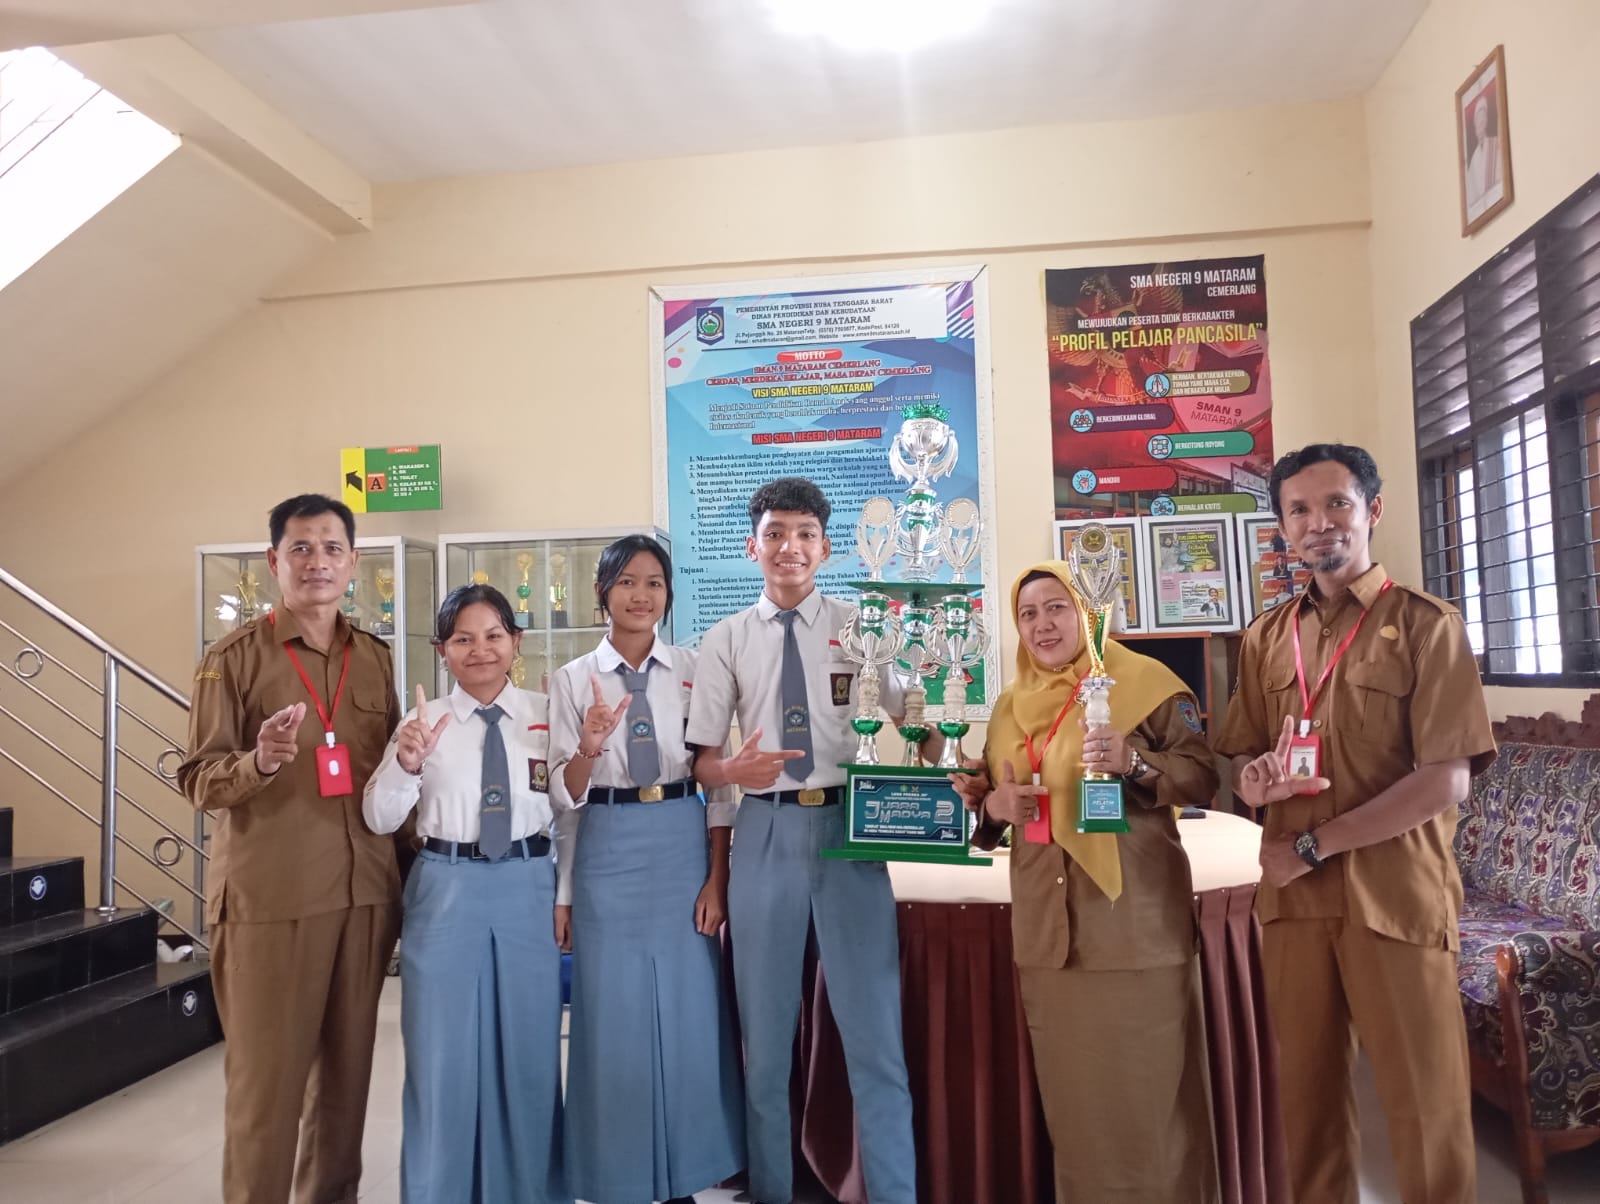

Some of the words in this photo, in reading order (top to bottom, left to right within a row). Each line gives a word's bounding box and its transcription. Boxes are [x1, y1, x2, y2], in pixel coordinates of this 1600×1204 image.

[1130, 274, 1154, 289] SMA
[1155, 271, 1192, 287] NEGERI
[1194, 270, 1202, 284] 9
[1204, 268, 1256, 284] MATARAM
[1207, 284, 1257, 297] CEMERLANG
[736, 304, 779, 313] PEMERINTAH
[781, 302, 812, 311] PROVINSI
[773, 310, 814, 319] PENDIDIKAN
[1077, 317, 1127, 329] MEWUJUDKAN
[1128, 314, 1160, 326] PESERTA
[1161, 312, 1181, 324] DIDIK
[1182, 310, 1235, 322] BERKARAKTER
[756, 321, 776, 330] SMA
[779, 318, 813, 328] NEGERI
[824, 316, 871, 326] MATARAM
[1112, 328, 1173, 349] PELAJAR
[794, 351, 826, 360] MOTTO
[785, 363, 826, 371] MATARAM
[828, 360, 880, 369] CEMERLANG
[706, 377, 740, 386] CERDAS,
[742, 375, 783, 384] MERDEKA
[784, 373, 822, 381] BELAJAR,
[824, 371, 847, 379] MASA
[849, 370, 876, 378] DEPAN
[878, 366, 931, 376] CEMERLANG
[1173, 380, 1189, 388] TUHAN
[752, 388, 769, 398] VISI
[770, 387, 789, 397] SMA
[791, 385, 821, 396] NEGERI
[823, 384, 829, 394] 9
[830, 382, 874, 394] MATARAM
[1196, 401, 1232, 415] SMAN
[1234, 408, 1243, 417] 9
[1190, 410, 1243, 426] MATARAM
[709, 421, 756, 431] Internasional
[752, 434, 772, 444] MISI
[773, 432, 794, 443] SMA
[795, 430, 826, 442] NEGERI
[828, 430, 835, 439] 9
[836, 427, 881, 440] MATARAM
[765, 459, 787, 467] sekolah
[789, 459, 804, 468] yang
[696, 470, 743, 478] Menumbuhkan
[709, 478, 733, 487] mampu
[734, 478, 761, 486] bersaing
[860, 472, 886, 480] maupun
[371, 477, 382, 490] A
[697, 487, 738, 496] Menyediakan
[834, 489, 863, 497] teknologi
[697, 505, 716, 513] proses
[697, 520, 724, 528] Nasional
[698, 528, 735, 537] Membentuk
[679, 567, 704, 575] Tujuan
